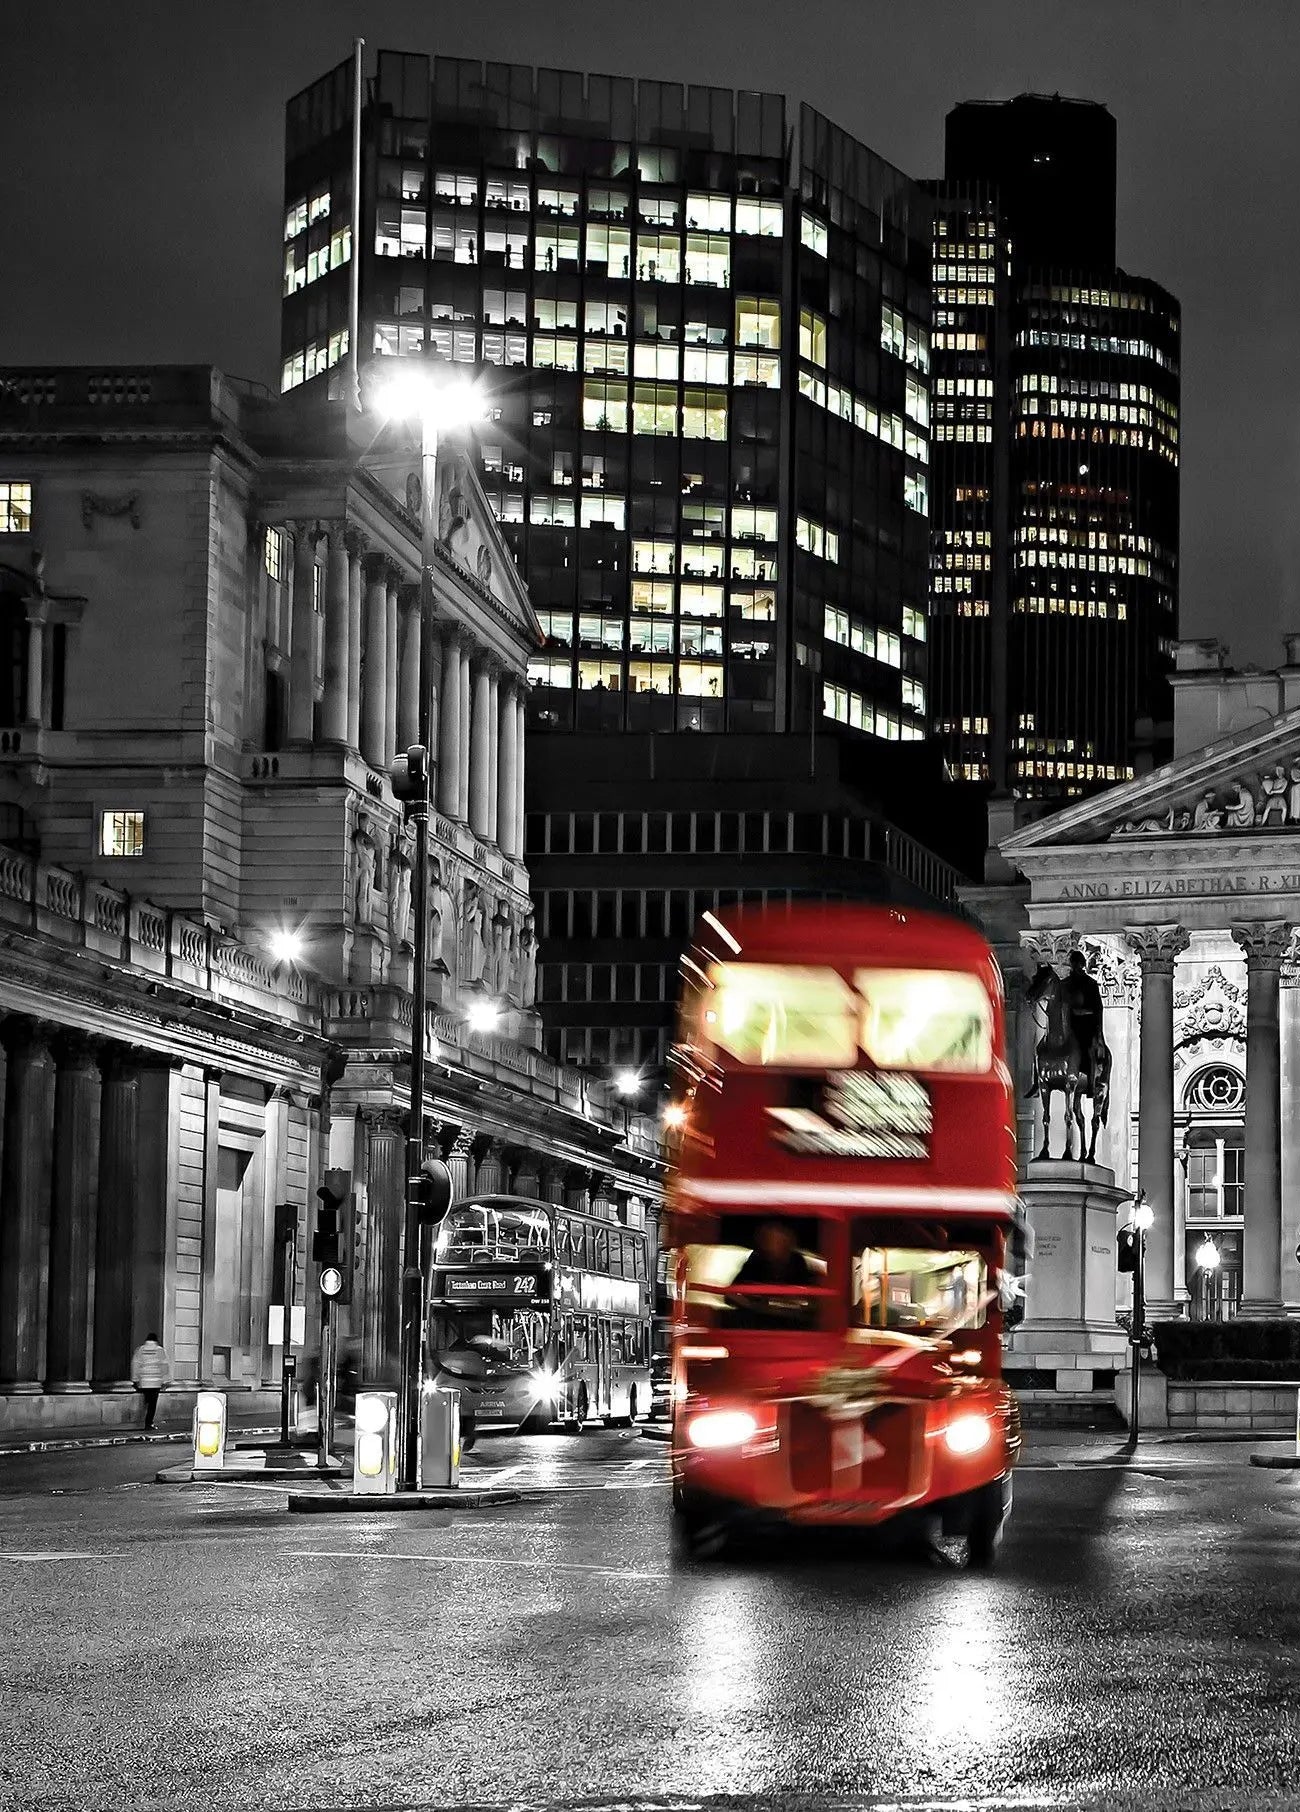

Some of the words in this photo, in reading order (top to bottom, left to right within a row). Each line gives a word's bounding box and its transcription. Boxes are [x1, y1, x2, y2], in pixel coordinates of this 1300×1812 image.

[1060, 882, 1109, 899] ANNO
[1121, 876, 1247, 896] ELIZABETHAE
[1259, 875, 1270, 891] R
[513, 1276, 536, 1294] 242
